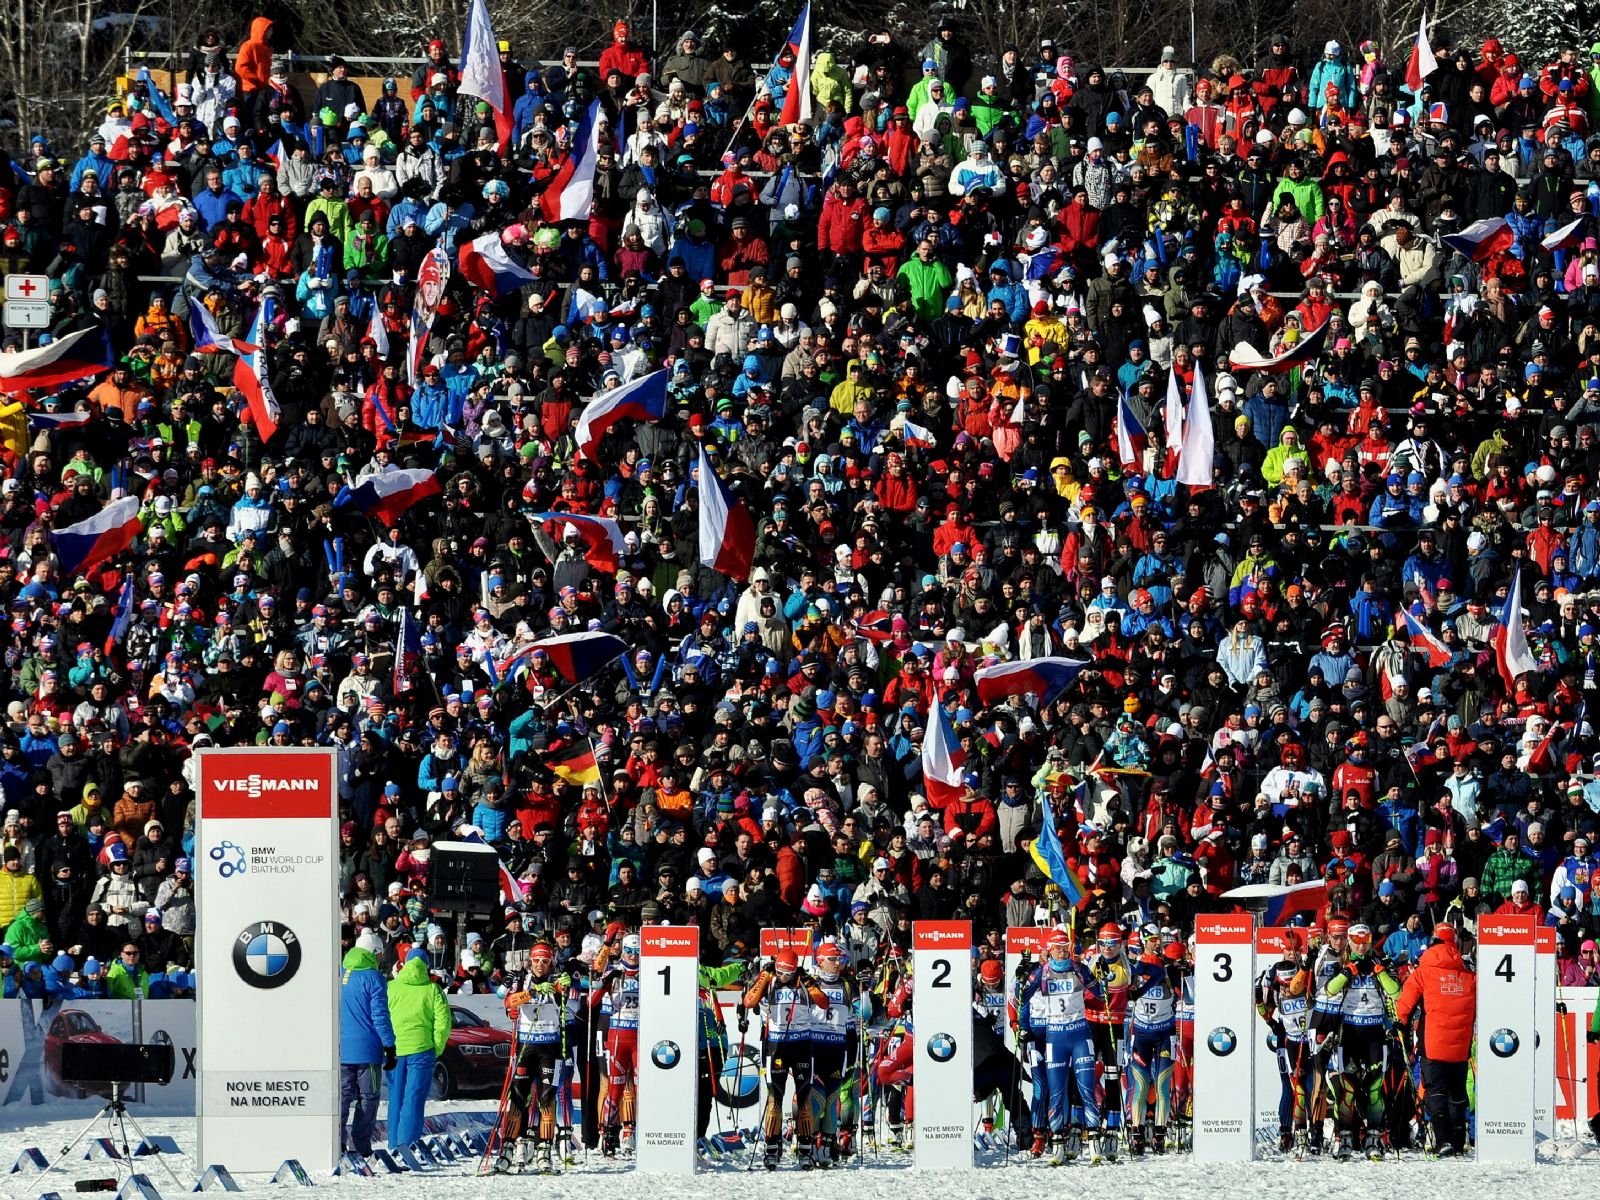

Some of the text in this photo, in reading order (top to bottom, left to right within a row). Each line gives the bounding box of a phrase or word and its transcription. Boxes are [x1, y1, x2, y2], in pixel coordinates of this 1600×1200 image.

[25, 313, 31, 322] 1
[213, 774, 319, 798] VIESSMANN
[251, 847, 276, 855] BMW
[251, 855, 324, 864] IBU WORLD CUP
[251, 865, 296, 874] BIATHLON
[238, 922, 296, 945] BMW
[919, 930, 965, 942] VIESSMANN
[1201, 924, 1246, 936] VIESSMANN
[1483, 925, 1529, 937] VIESSMANN
[645, 937, 691, 949] VIESSMANN
[931, 958, 952, 988] 2
[1212, 952, 1233, 982] 3
[1494, 953, 1516, 983] 4
[657, 965, 671, 996] 1
[1048, 982, 1073, 993] DKB
[1147, 987, 1163, 998] KB
[625, 996, 638, 1009] 25
[1360, 993, 1369, 1005] 4
[1058, 998, 1067, 1013] 3
[1144, 1002, 1157, 1015] 15
[1283, 1000, 1306, 1012] DKB
[826, 1006, 835, 1020] 6
[1048, 1020, 1086, 1032] BMW xDrive
[534, 1033, 557, 1042] xDrive
[226, 1080, 310, 1092] NOVE MESTO
[230, 1096, 306, 1107] NA MORAVE
